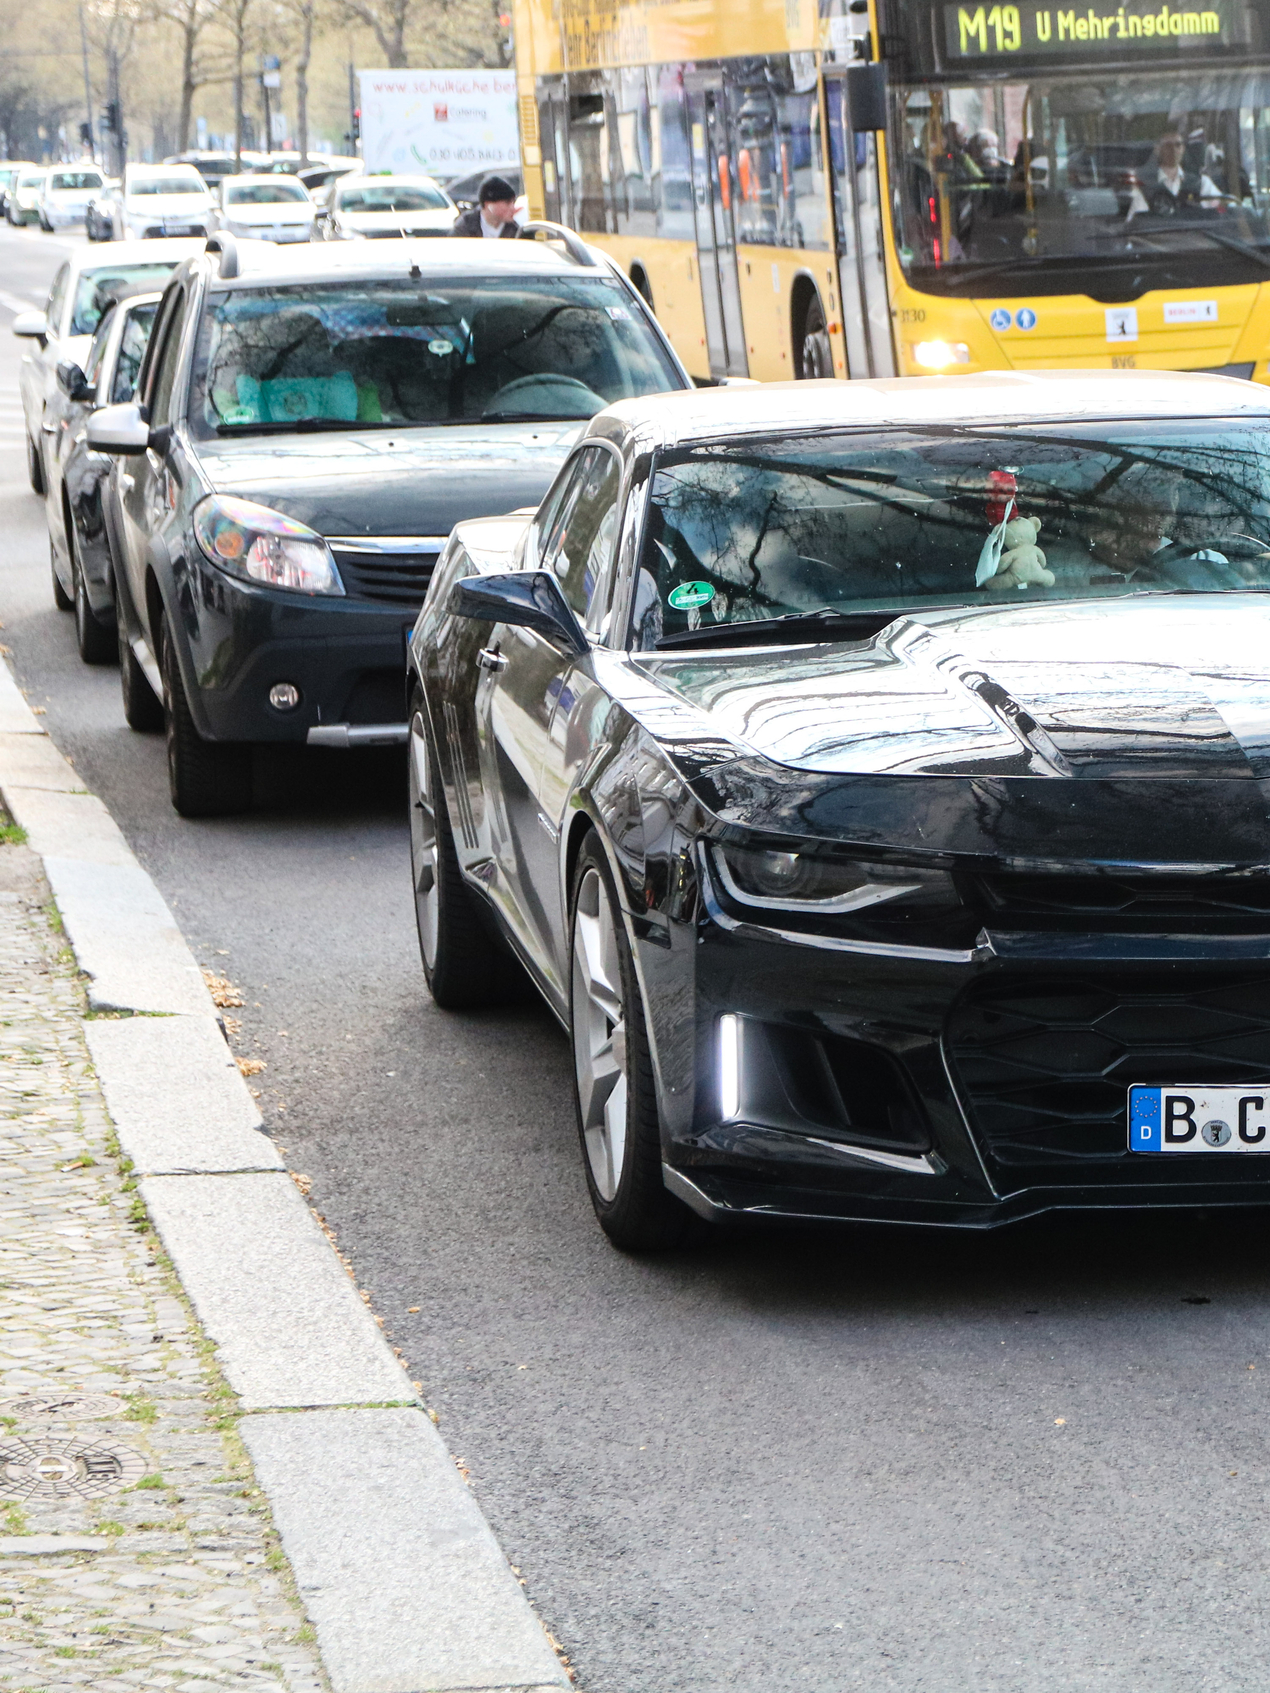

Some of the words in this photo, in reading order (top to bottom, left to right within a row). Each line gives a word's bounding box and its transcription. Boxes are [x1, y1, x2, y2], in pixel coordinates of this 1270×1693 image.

[957, 5, 1022, 52] M19
[1036, 11, 1052, 42] U
[1057, 5, 1220, 41] Mehringdamm
[449, 106, 487, 118] Catering
[1167, 306, 1197, 317] BERLIN
[1111, 355, 1136, 369] BVG
[686, 583, 699, 594] 4
[1164, 1095, 1198, 1144] B
[1140, 1126, 1152, 1140] D
